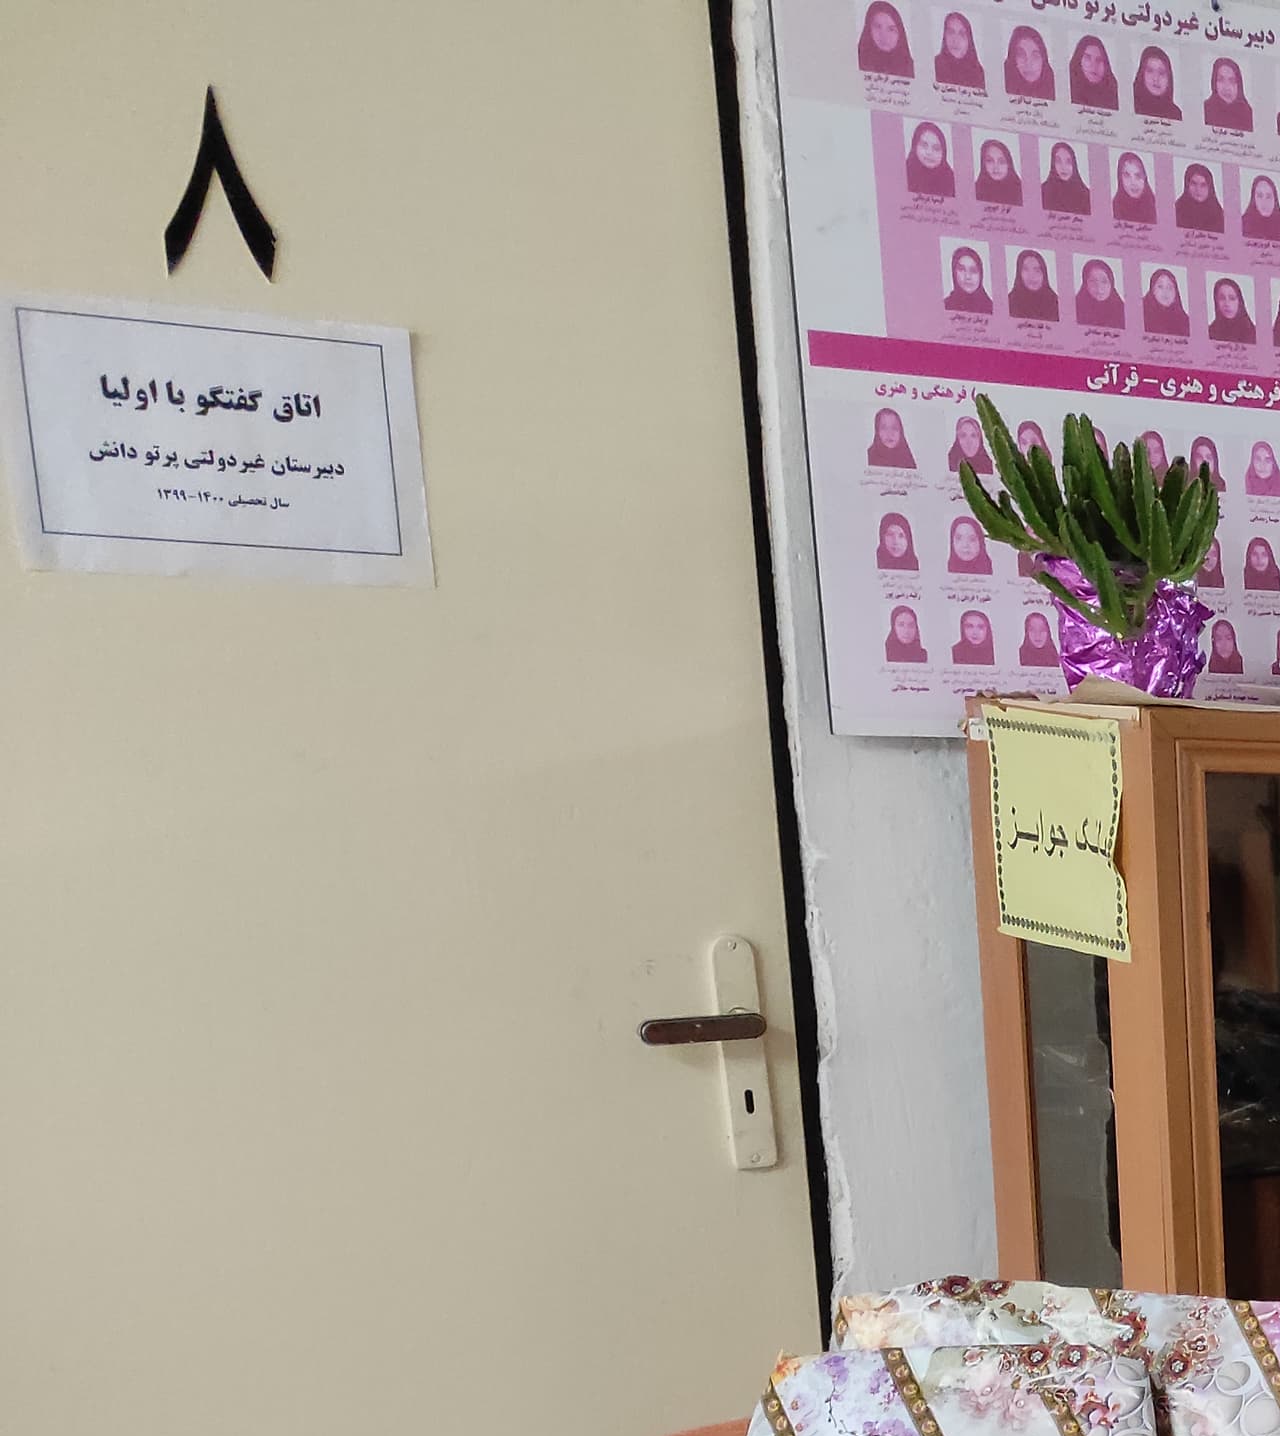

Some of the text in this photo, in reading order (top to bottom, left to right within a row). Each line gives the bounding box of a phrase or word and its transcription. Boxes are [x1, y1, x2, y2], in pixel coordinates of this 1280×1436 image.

[1205, 16, 1275, 49] دبیرستان
[1086, 363, 1140, 394] قرآنی
[99, 373, 321, 423] اتاق گفتگو با اولیا
[874, 381, 968, 404] فرهنگی و هنری
[1207, 384, 1218, 402] و
[88, 441, 138, 462] دانش
[143, 444, 179, 470] پرتو
[271, 455, 345, 479] دبیرستان
[228, 495, 268, 508] تحصیلی
[269, 497, 291, 509] سال
[1007, 806, 1069, 858] جوایز
